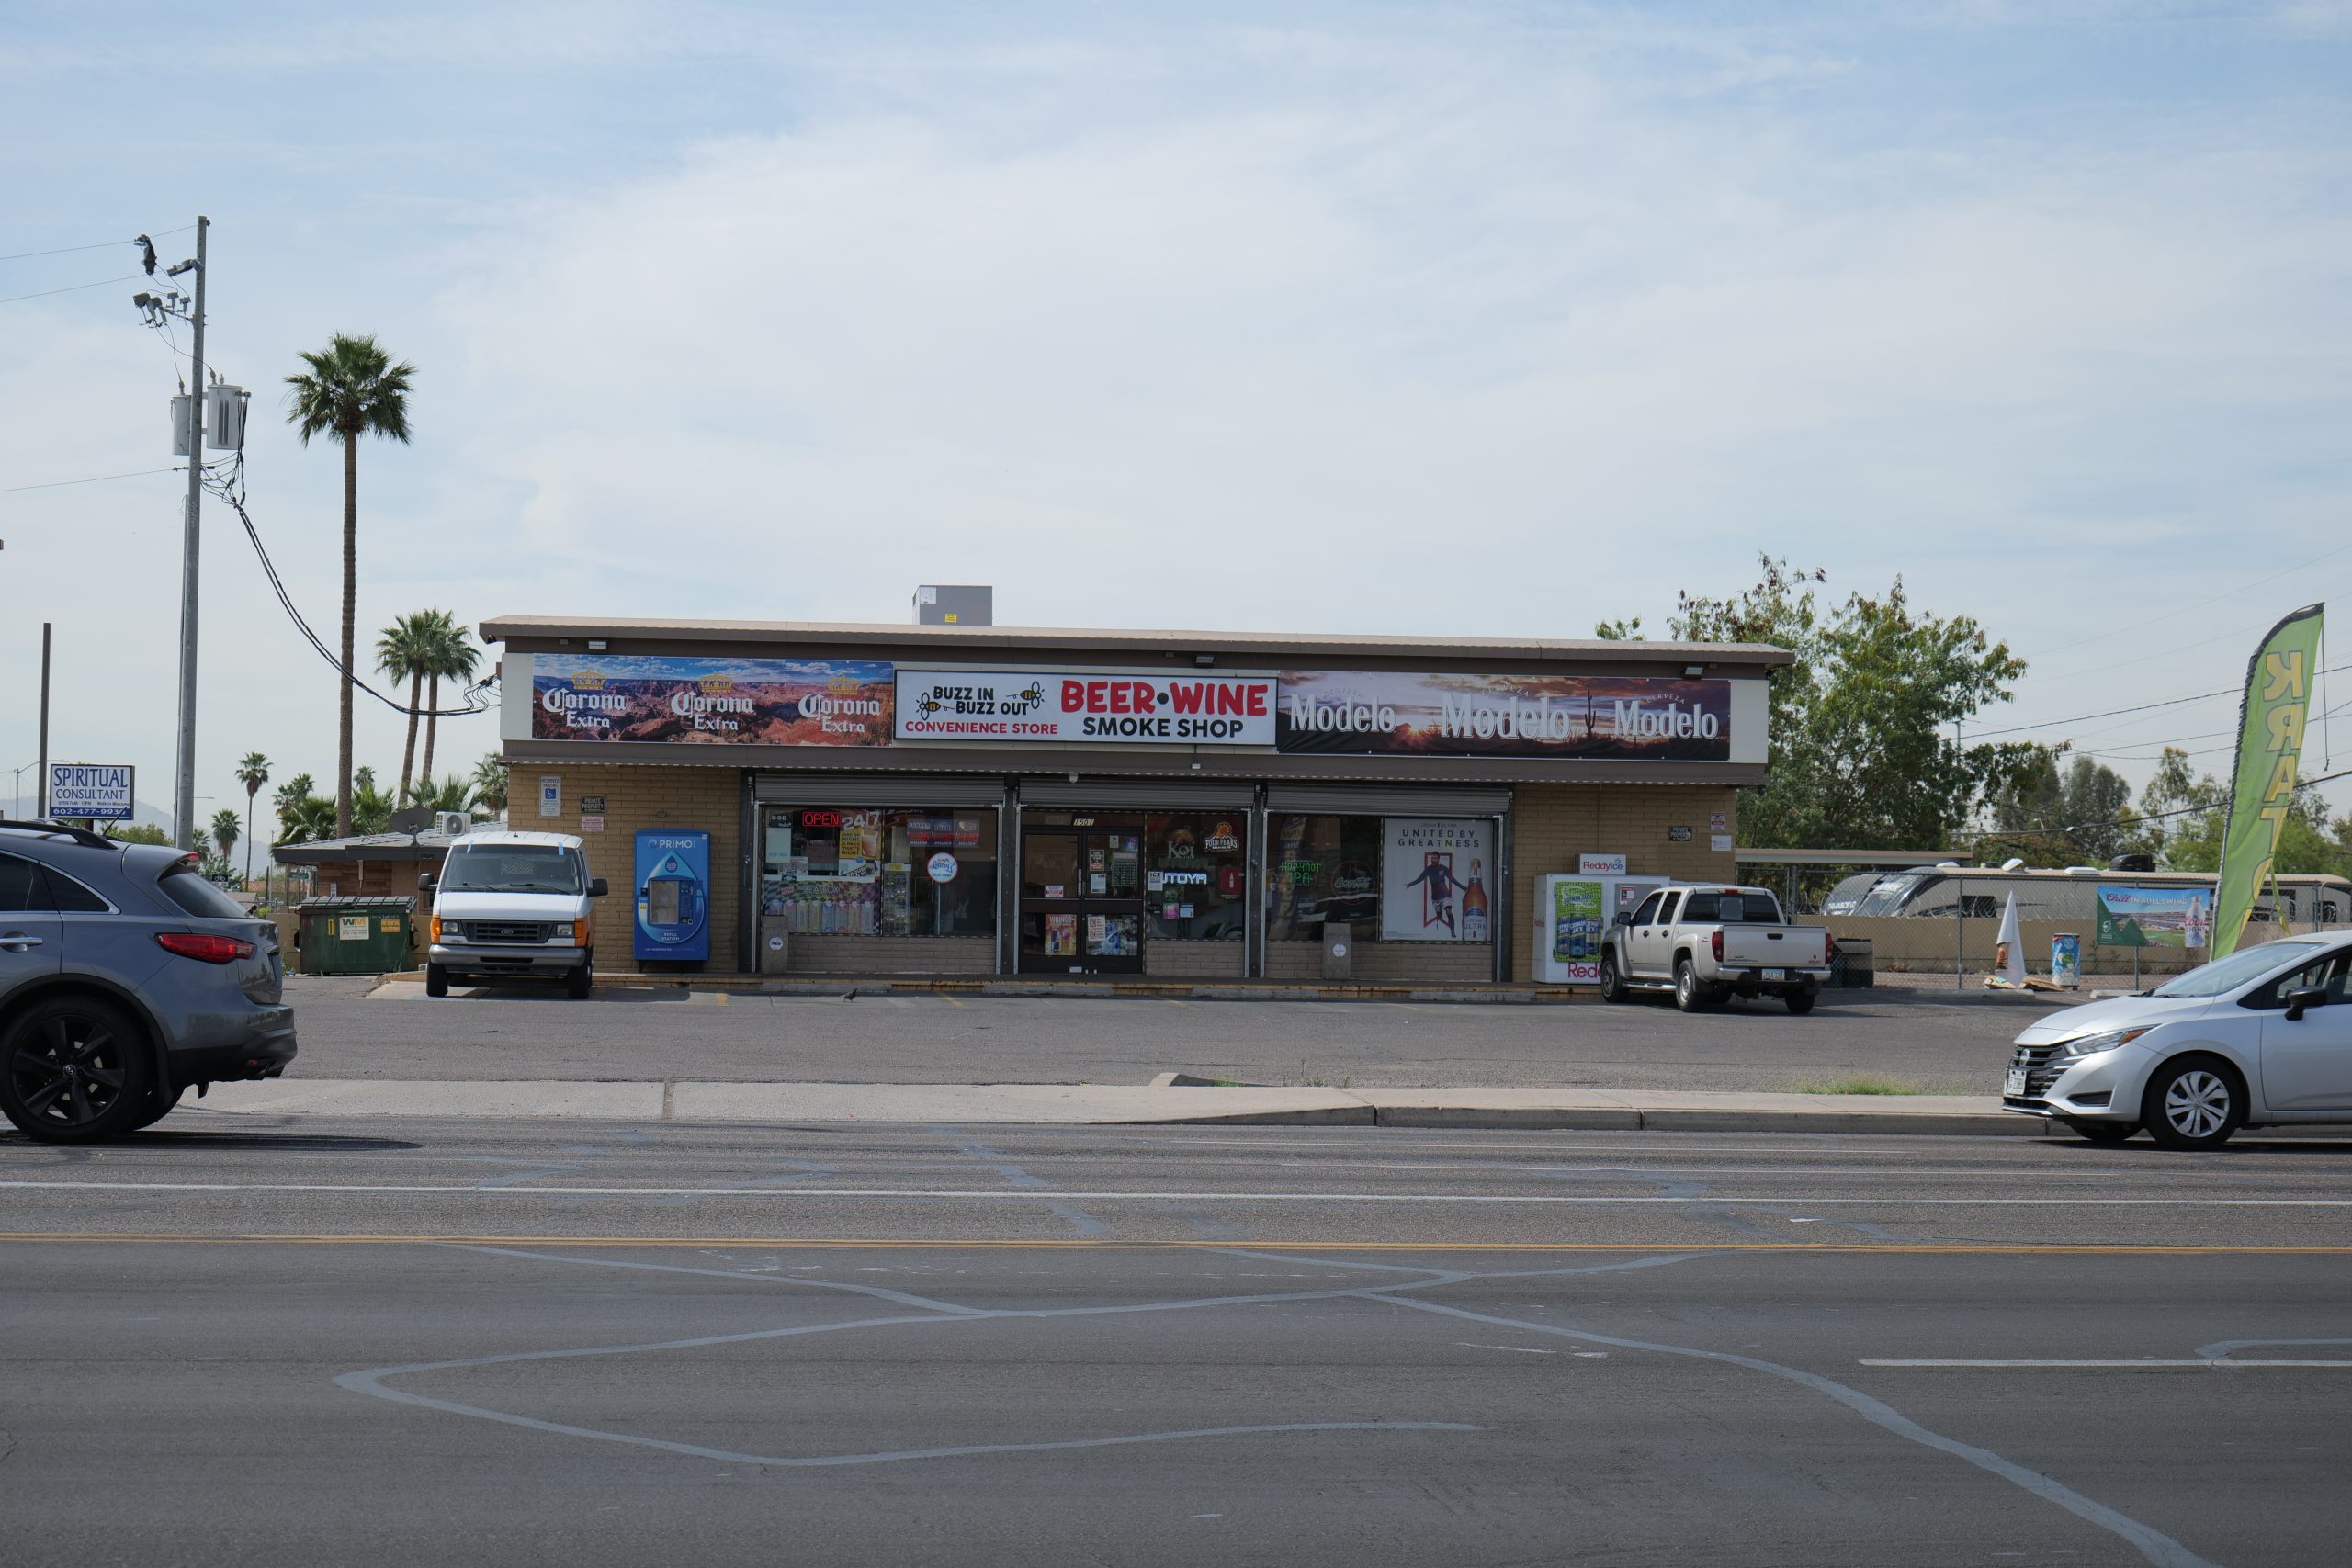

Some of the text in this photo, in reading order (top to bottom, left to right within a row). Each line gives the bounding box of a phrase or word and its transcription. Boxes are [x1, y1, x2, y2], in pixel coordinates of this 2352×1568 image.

[933, 686, 994, 701] BUZZ IN
[1061, 680, 1269, 716] BEER WINE
[1482, 683, 1530, 698] CERVEZA
[542, 687, 627, 715] Corona
[671, 691, 755, 717] Corona
[1646, 693, 1685, 705] CERVEZA
[798, 694, 882, 720] Corona
[956, 700, 1029, 716] BUZZ OUT
[1289, 694, 1396, 733] Modelo
[566, 711, 610, 728] Extra
[695, 715, 738, 731] Extra
[1442, 692, 1571, 739] Modelo
[1614, 700, 1718, 739] Modelo
[821, 716, 865, 734] Extra
[906, 720, 1058, 735] CONVENIENCE STORE
[1082, 716, 1244, 739] SMOKE SHOP
[54, 767, 128, 787] SPIRITUAL
[56, 789, 125, 799] CONSULTANT
[804, 813, 840, 825] OPEN
[1402, 829, 1453, 838] UNITED
[659, 840, 694, 849] PRIMO
[1205, 838, 1238, 849] FOUR PEAKS
[1398, 839, 1480, 848] GREATNESS
[1287, 872, 1313, 884] IPA
[2105, 892, 2132, 903] Chill
[1464, 922, 1487, 931] ULTRA
